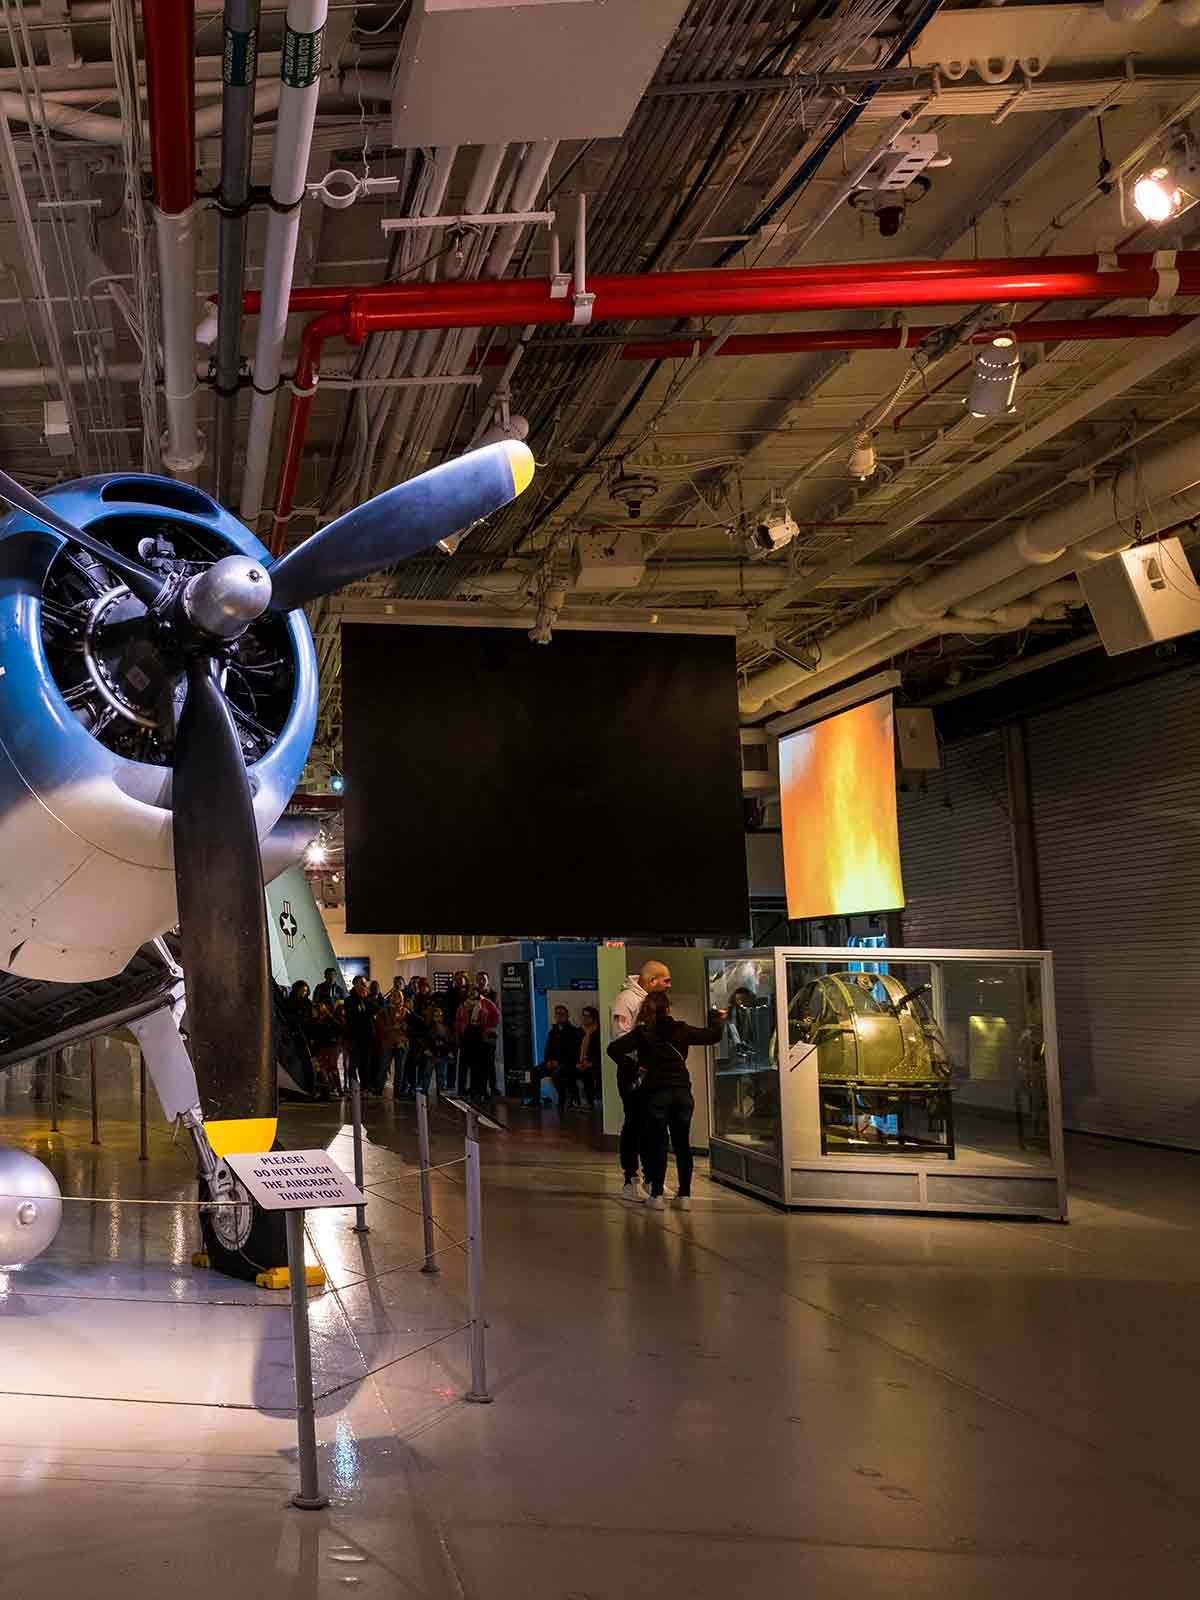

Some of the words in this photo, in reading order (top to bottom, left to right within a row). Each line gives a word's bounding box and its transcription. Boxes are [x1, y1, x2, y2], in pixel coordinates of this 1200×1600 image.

[260, 1155, 307, 1165] PLEASE!
[254, 1169, 272, 1178] DO
[272, 1168, 294, 1177] NOT
[294, 1166, 333, 1175] TOUCH
[261, 1180, 286, 1190] THE
[286, 1178, 343, 1189] AIRCRAFT.
[278, 1191, 316, 1201] THANK
[316, 1189, 345, 1199] YOU!
